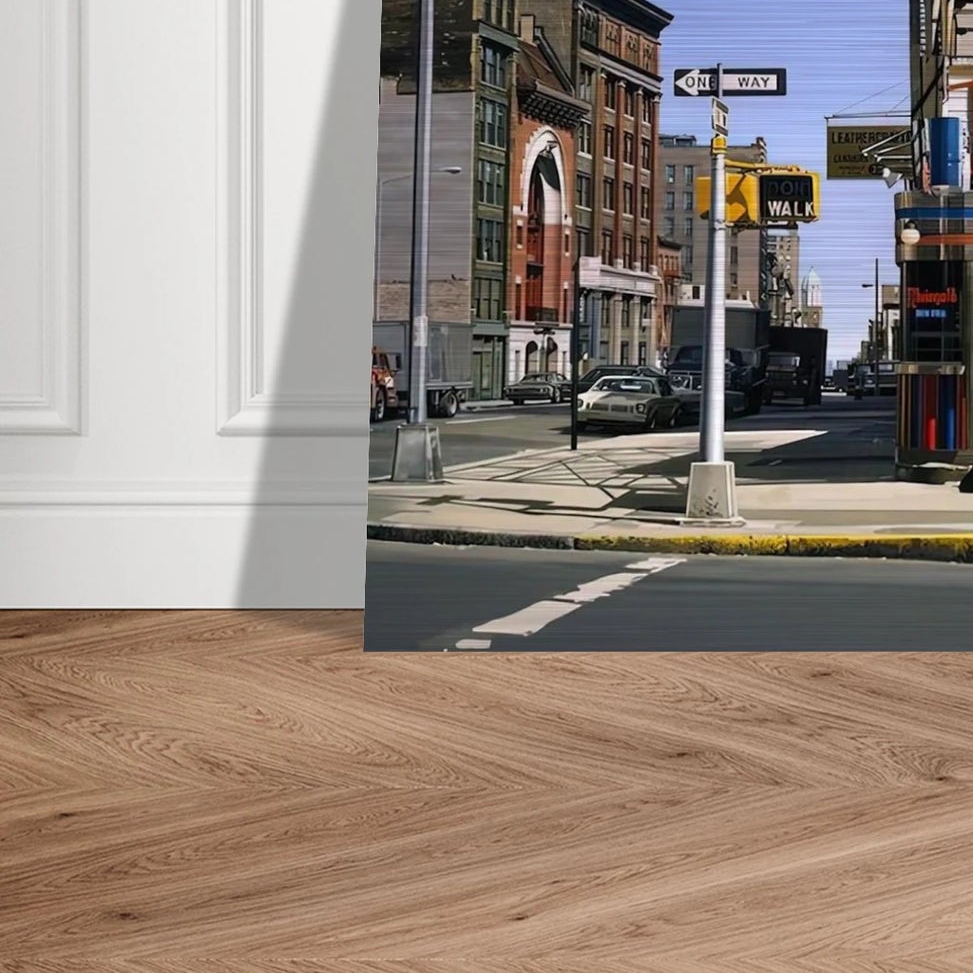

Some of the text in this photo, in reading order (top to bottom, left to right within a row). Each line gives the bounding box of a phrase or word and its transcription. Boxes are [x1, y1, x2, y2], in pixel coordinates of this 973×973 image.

[685, 76, 770, 88] ONE WAY
[767, 200, 815, 217] WALK
